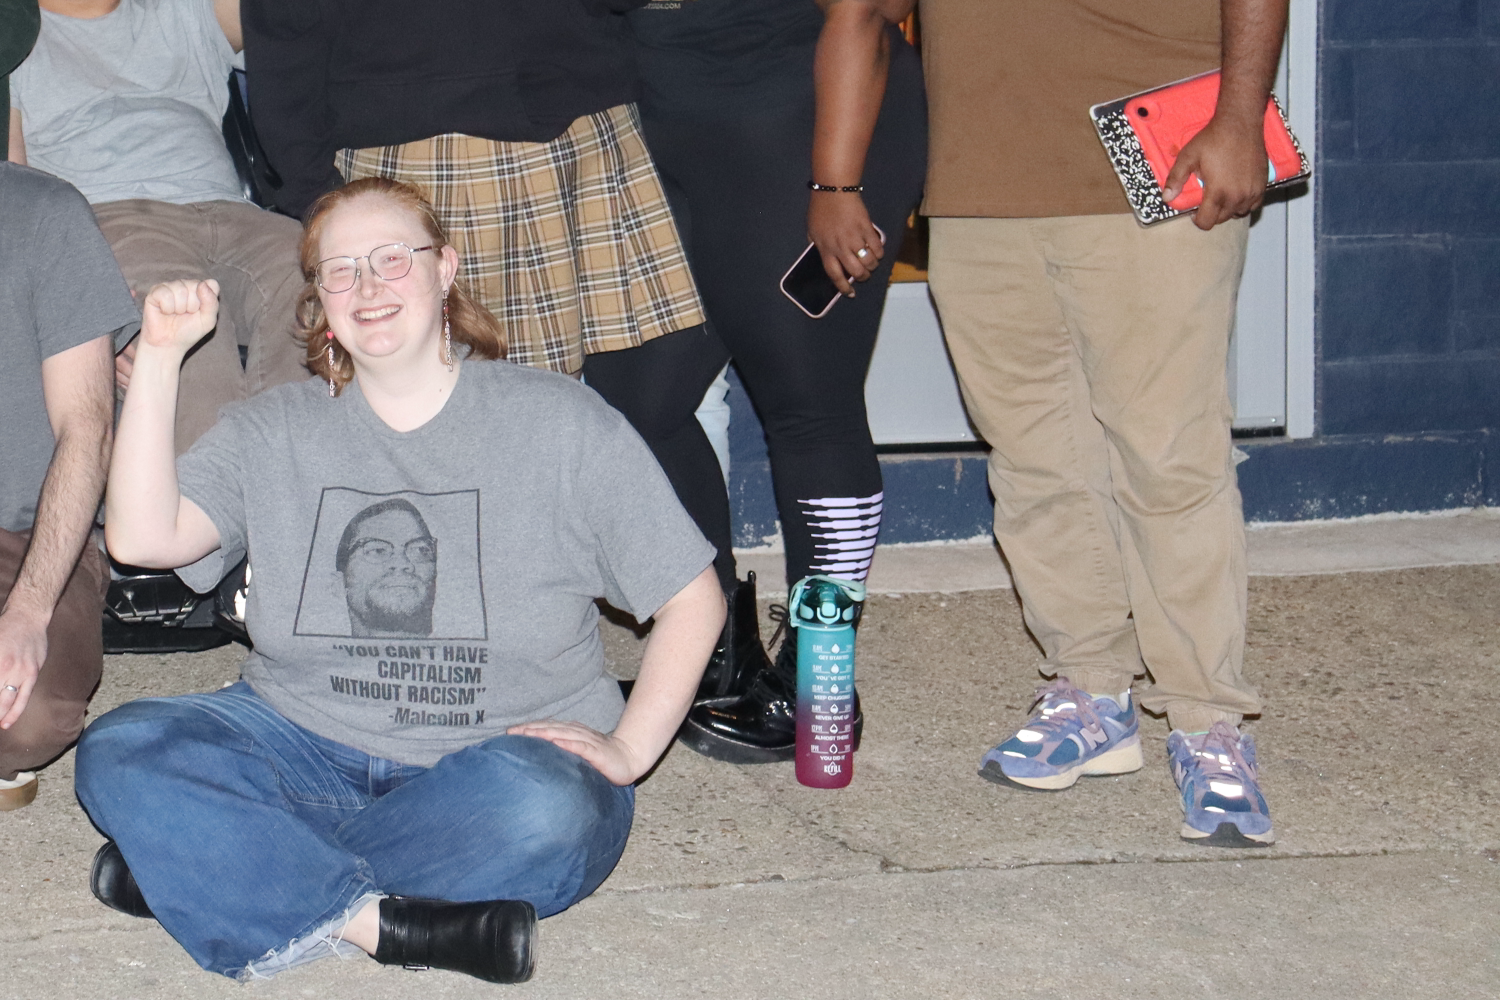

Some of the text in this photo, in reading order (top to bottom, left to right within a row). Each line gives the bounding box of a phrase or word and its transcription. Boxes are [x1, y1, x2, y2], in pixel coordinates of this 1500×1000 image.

[332, 644, 488, 664] "YOU CAN'T HAVE
[377, 660, 482, 684] CAPITALISM
[329, 675, 487, 706] WITHOUT RACISM"
[388, 707, 485, 726] -Malcolm X
